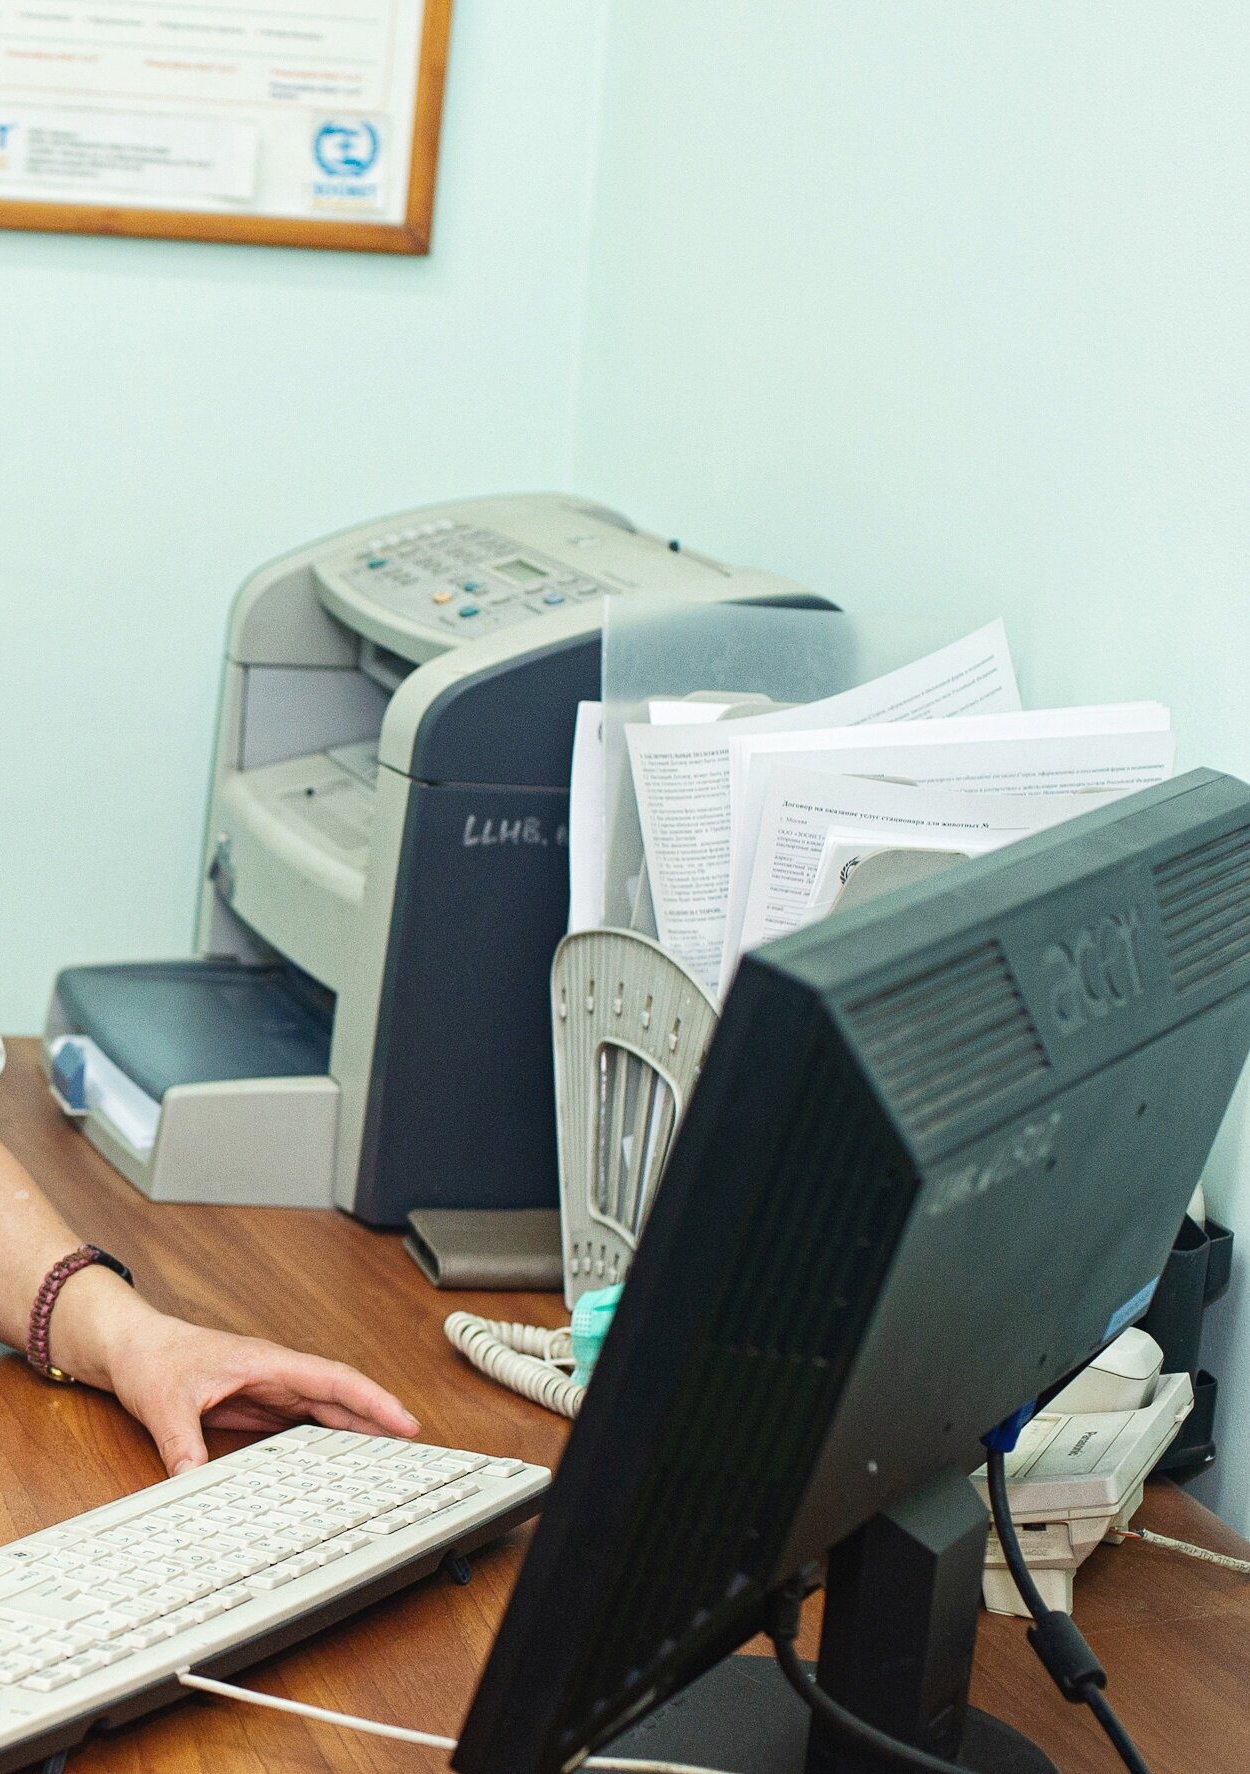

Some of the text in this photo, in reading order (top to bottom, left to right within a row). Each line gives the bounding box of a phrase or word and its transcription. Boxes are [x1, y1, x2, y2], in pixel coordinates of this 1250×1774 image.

[782, 800, 813, 811] Договор
[825, 807, 858, 817] оказание
[881, 816, 925, 826] стационара
[1040, 904, 1146, 1034] acer
[1067, 1431, 1098, 1456] Panasonic
